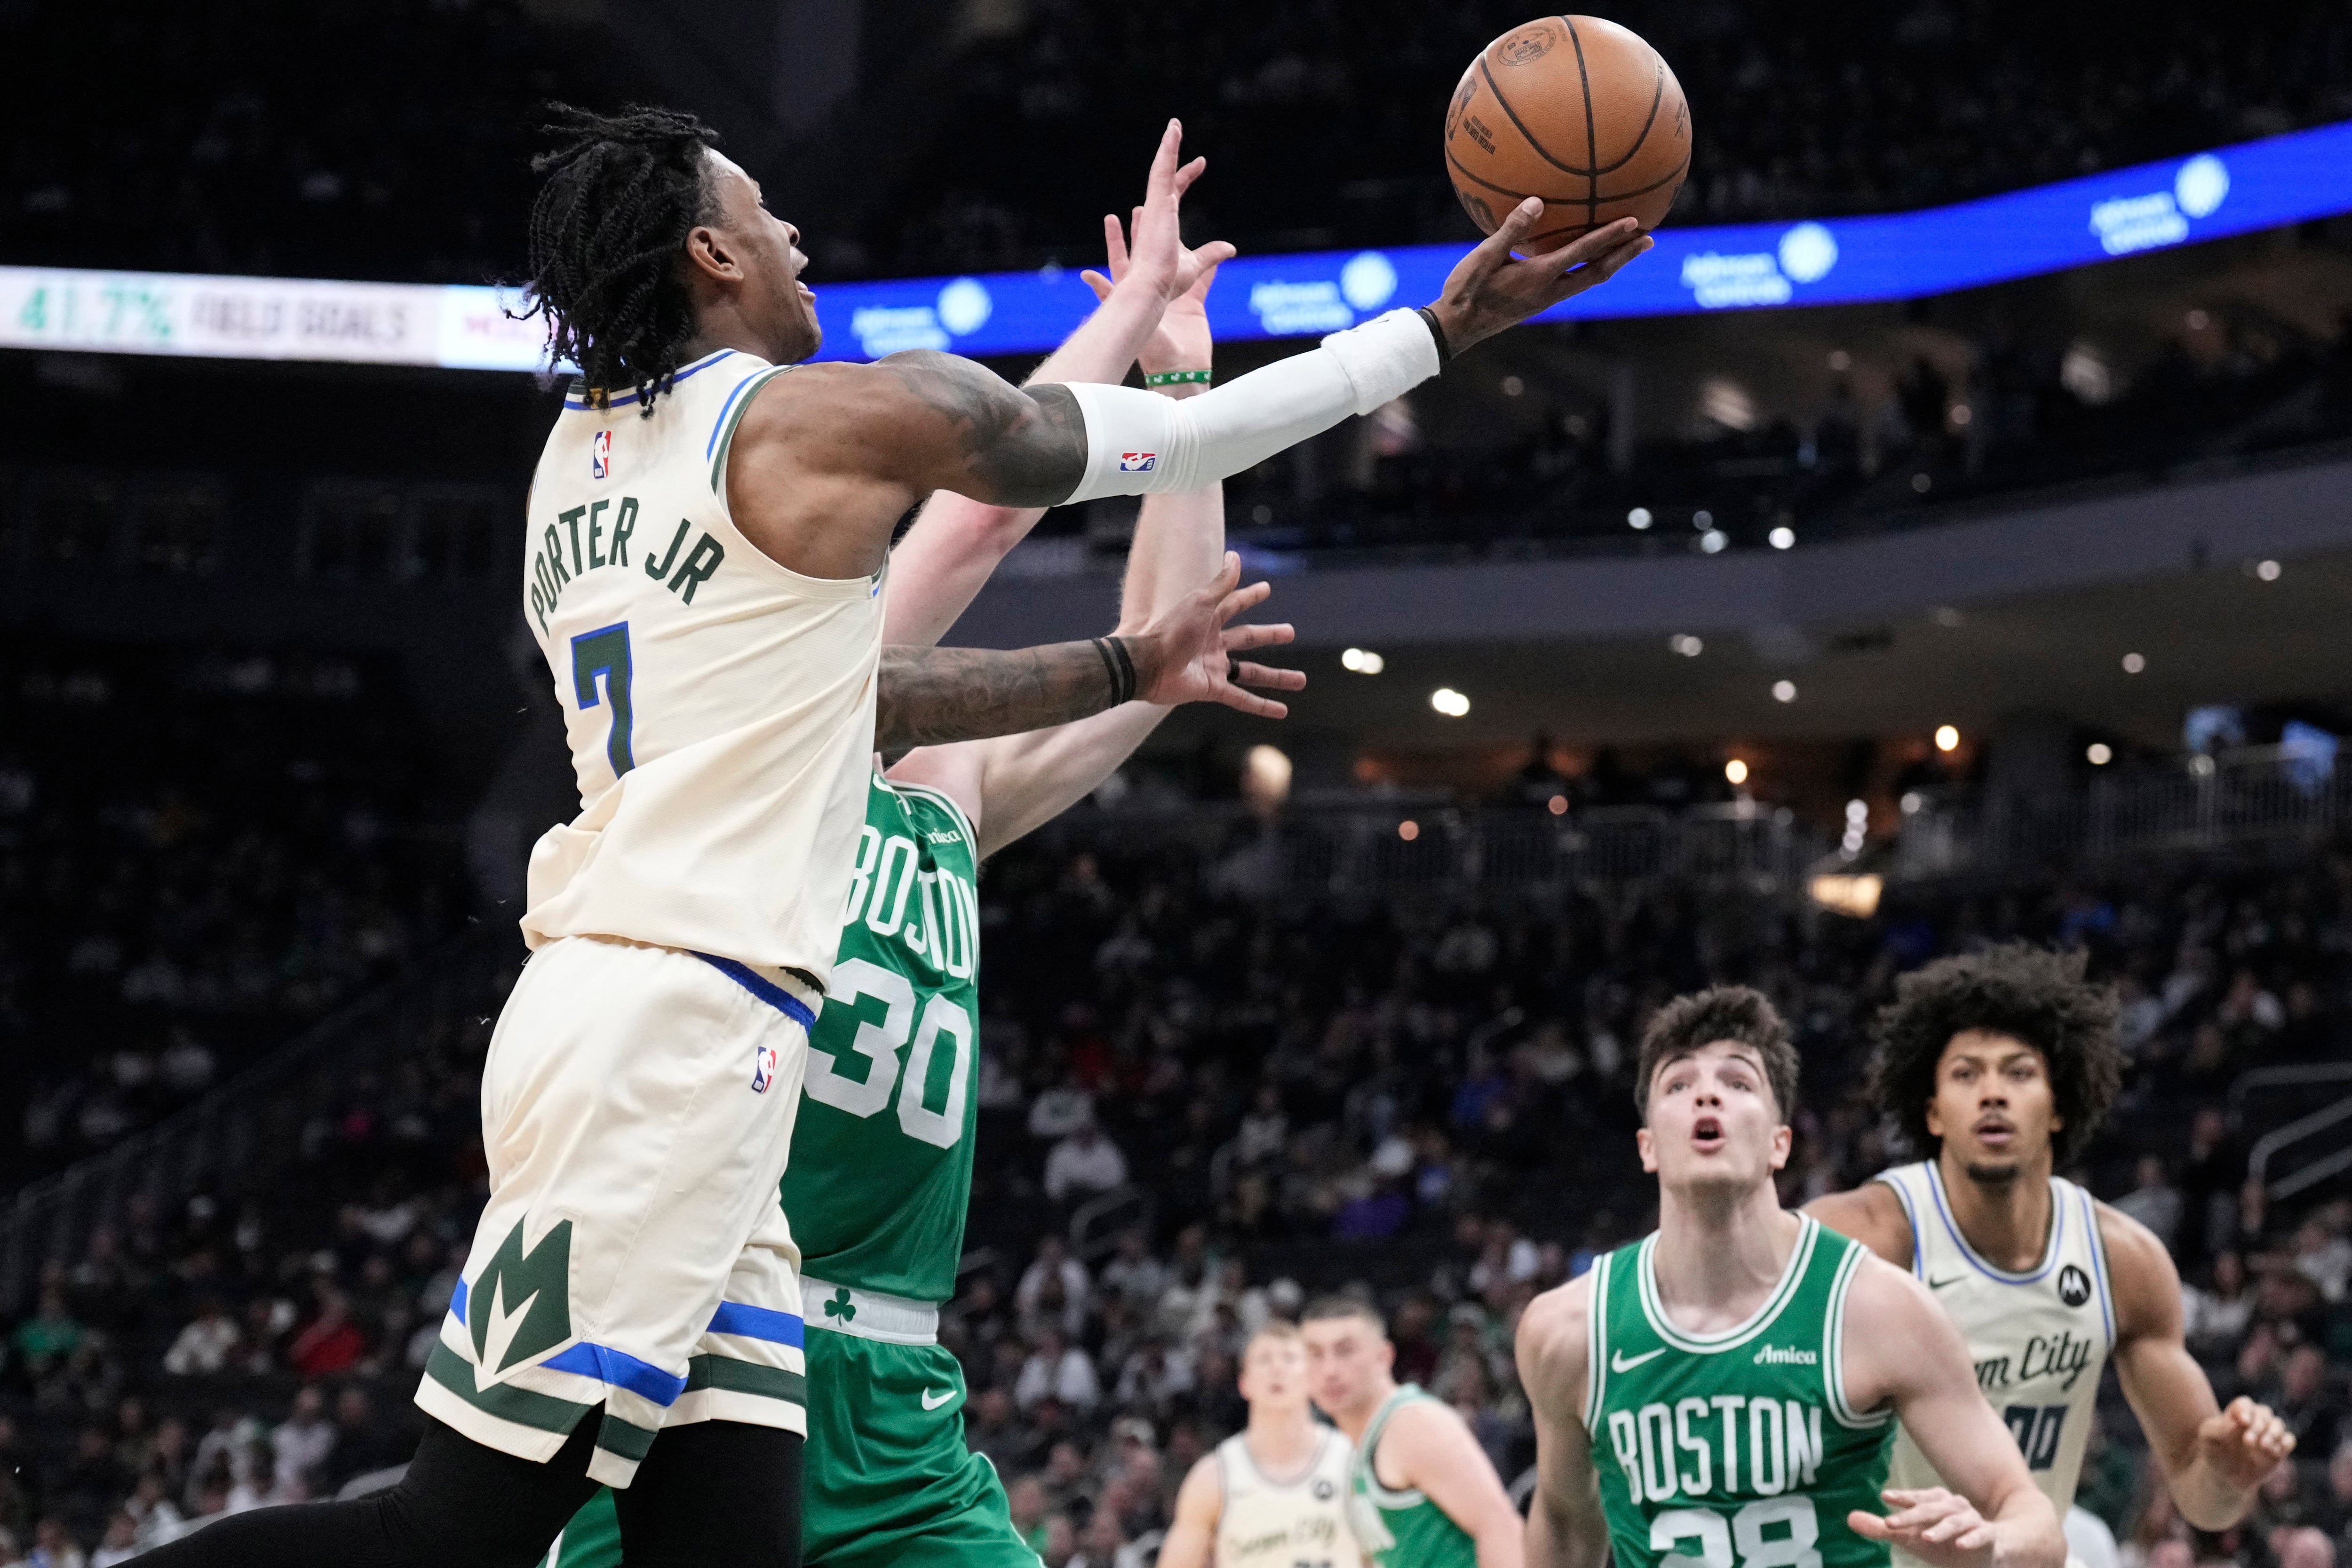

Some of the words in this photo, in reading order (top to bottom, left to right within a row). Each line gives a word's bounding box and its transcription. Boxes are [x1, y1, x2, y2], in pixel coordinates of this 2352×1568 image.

[531, 497, 639, 640] PORTER
[645, 518, 725, 606] JR
[570, 620, 635, 781] 7
[803, 957, 972, 1150] 30
[1753, 1344, 1818, 1365] Amica
[2020, 1331, 2091, 1393] City
[1608, 1395, 1823, 1505] BOSTON
